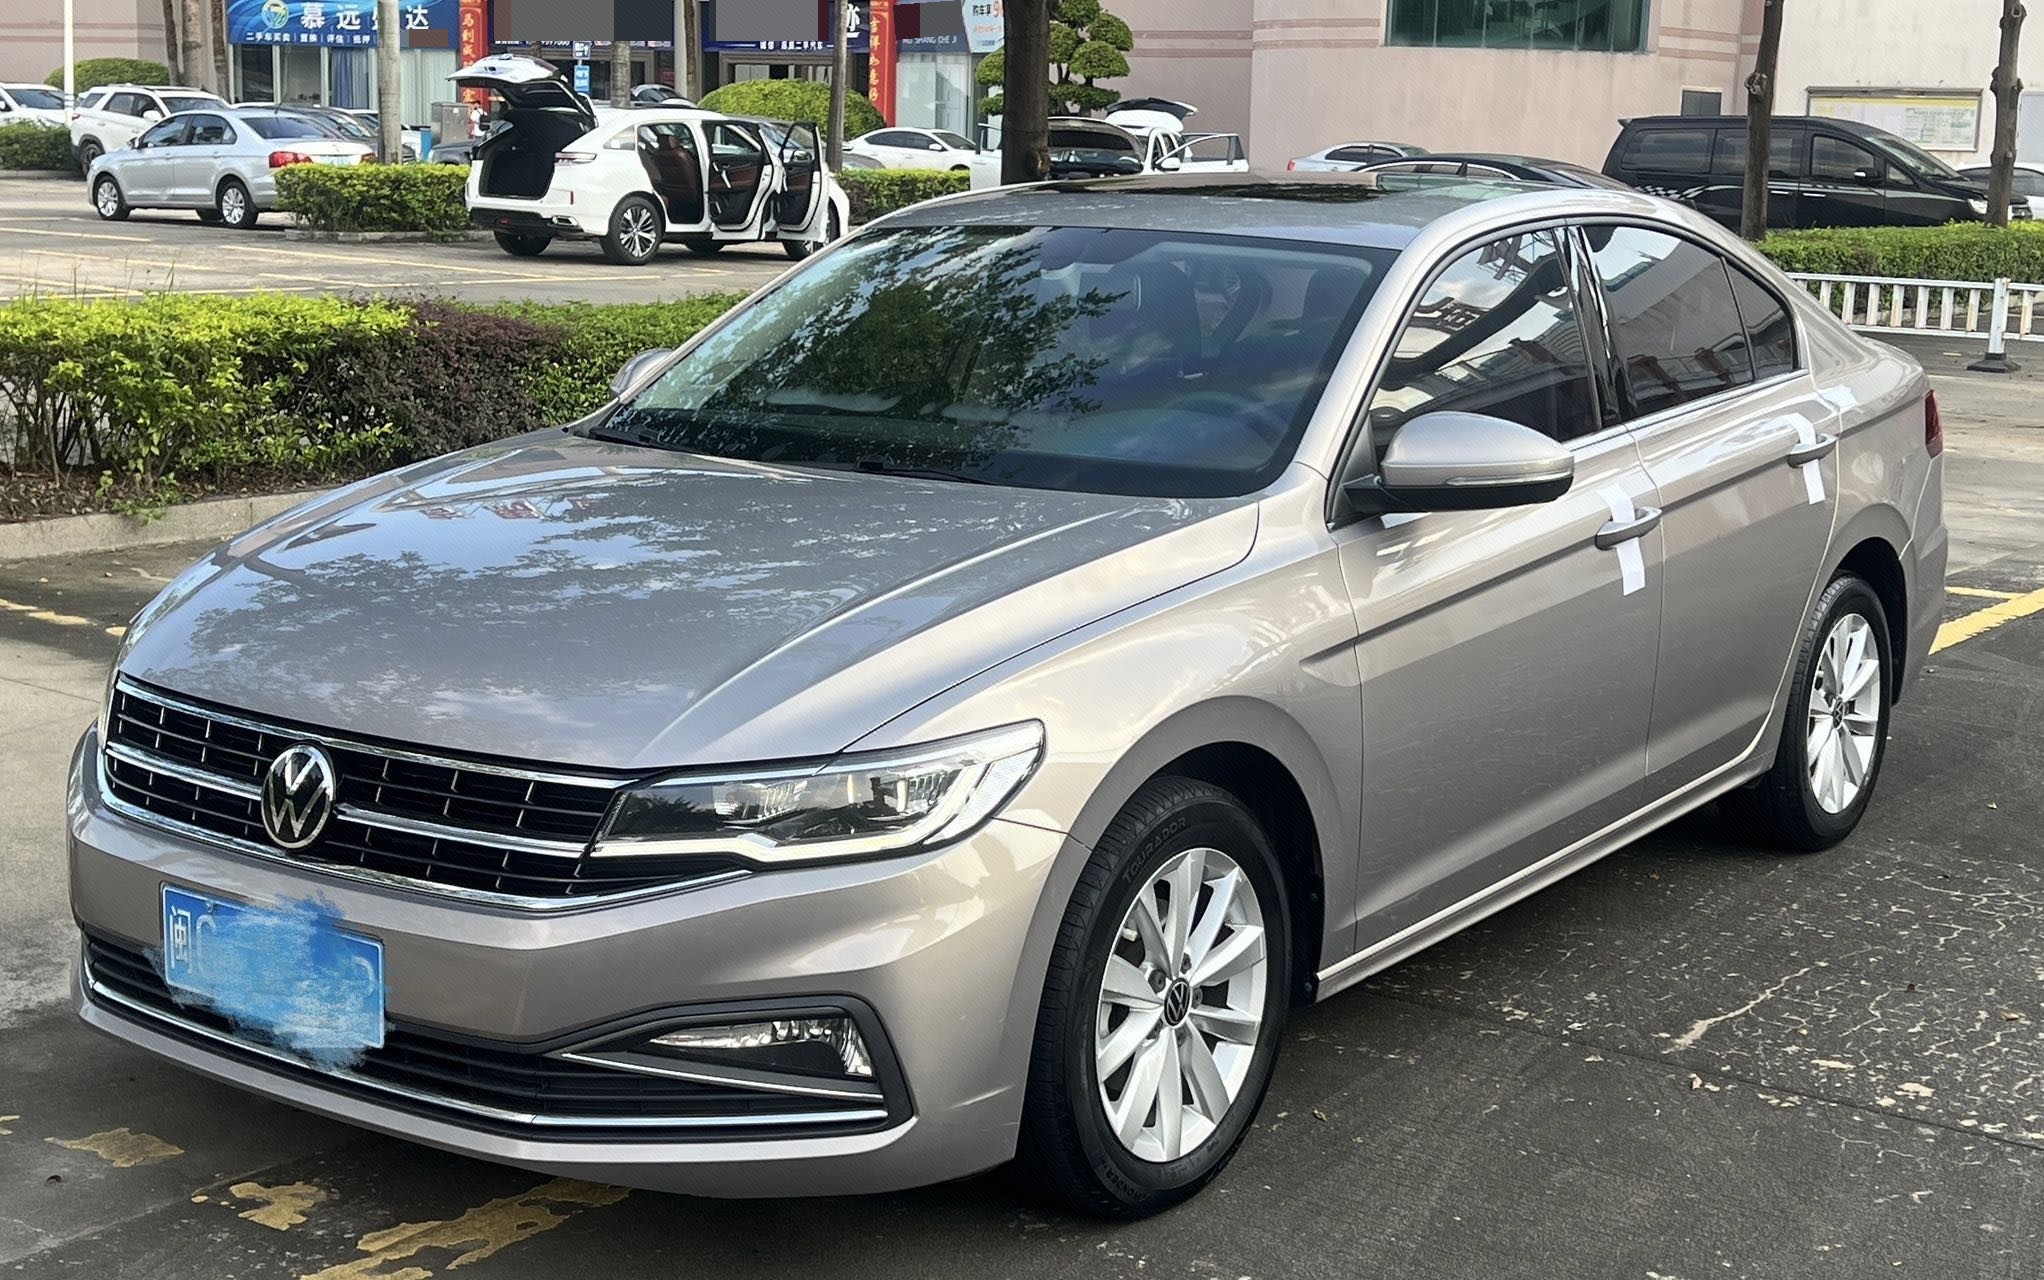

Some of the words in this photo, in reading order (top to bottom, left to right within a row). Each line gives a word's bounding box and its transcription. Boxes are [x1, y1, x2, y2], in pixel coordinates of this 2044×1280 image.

[301, 2, 429, 30] 慕远达
[246, 32, 290, 43] 二手车买卖
[1122, 816, 1187, 883] TOURADOR
